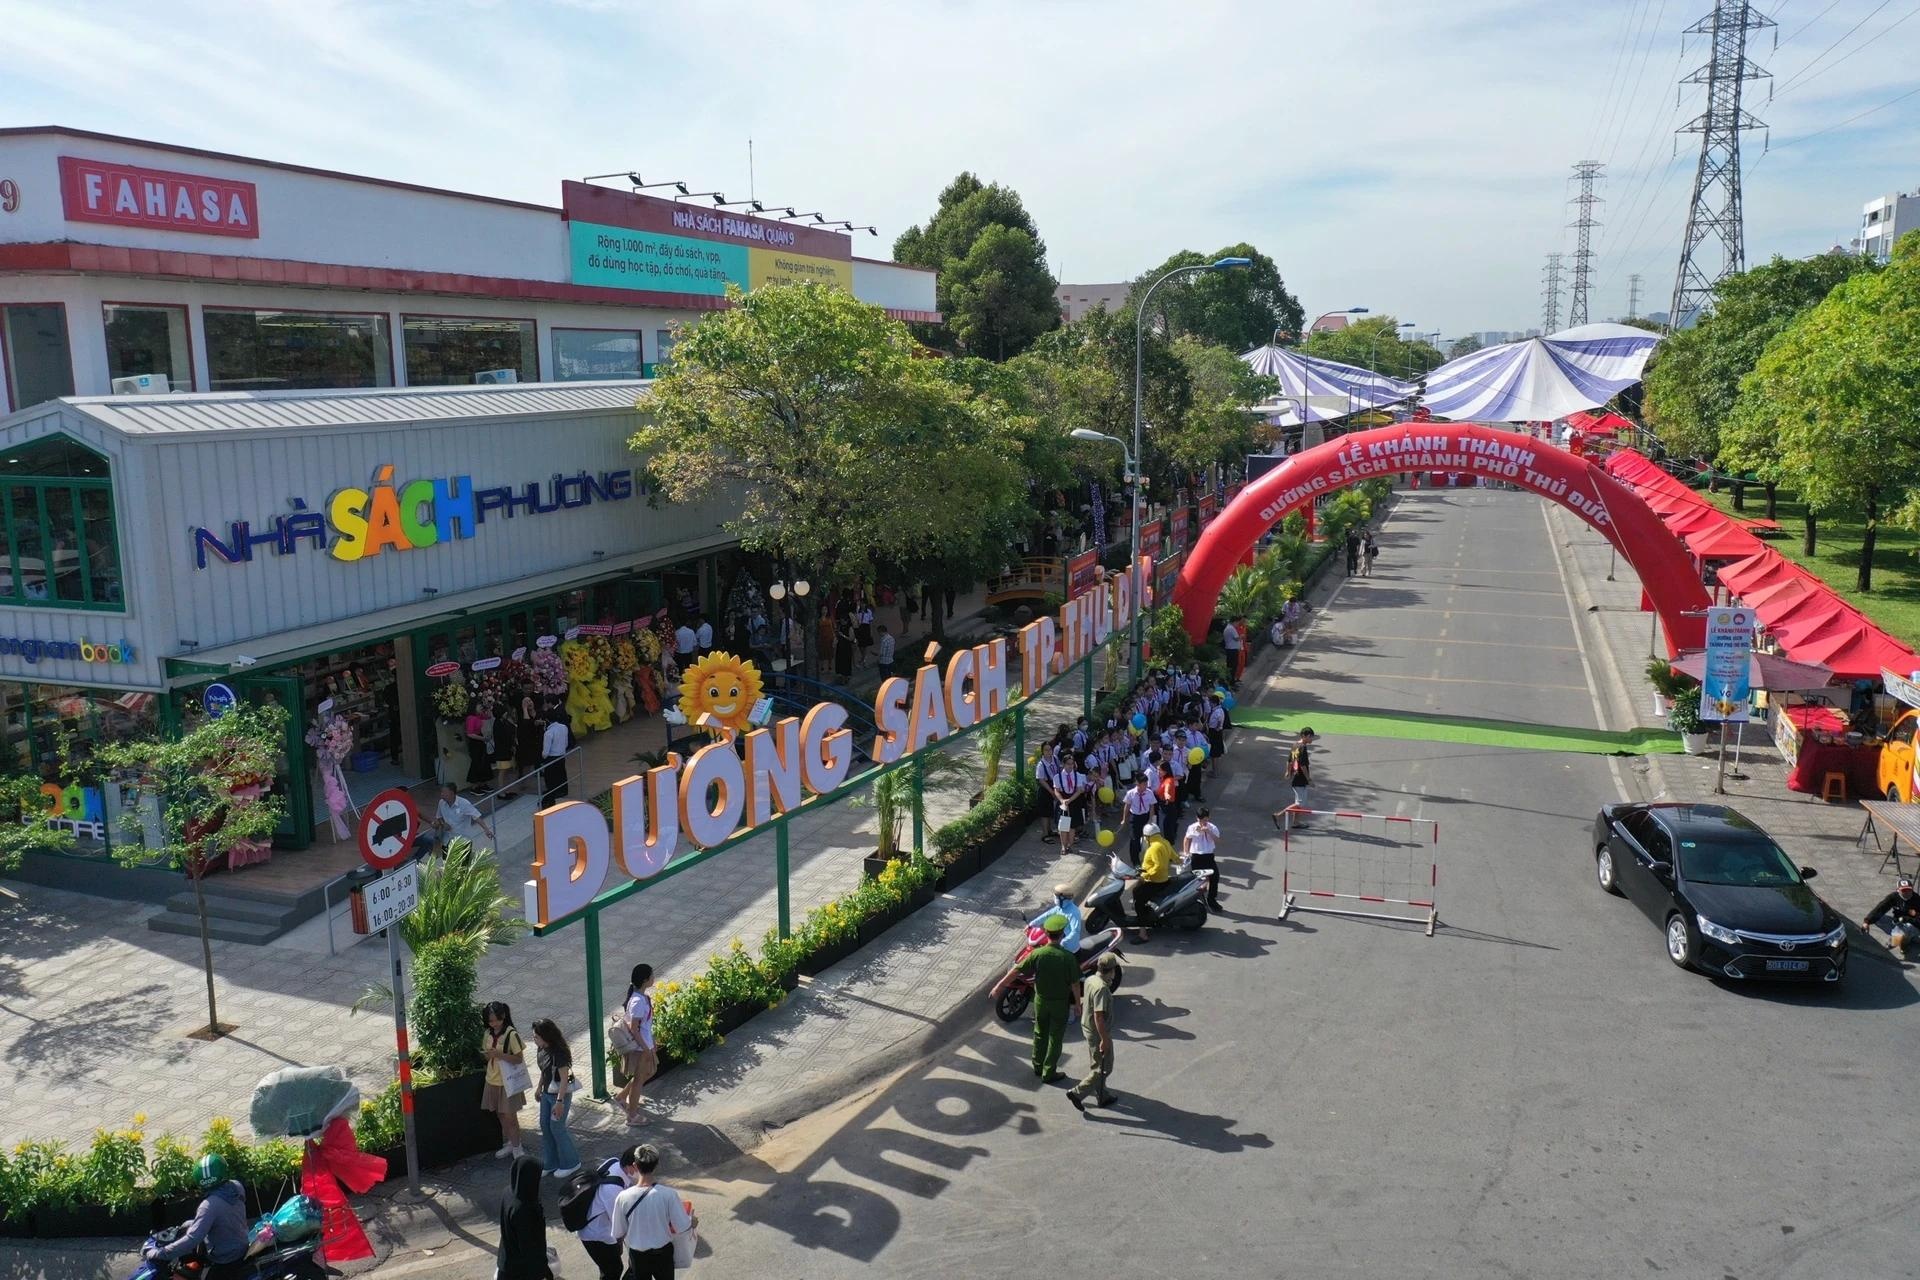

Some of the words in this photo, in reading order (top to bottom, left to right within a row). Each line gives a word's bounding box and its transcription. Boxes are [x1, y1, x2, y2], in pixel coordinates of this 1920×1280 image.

[85, 174, 248, 226] FAHASA
[597, 235, 620, 252] Rộng
[623, 238, 644, 253] 1.000
[685, 247, 705, 261] sách,
[673, 210, 695, 229] NHÀ
[696, 213, 721, 234] SÁCH
[722, 218, 765, 241] FAHASA
[765, 229, 789, 247] QUẬN
[788, 231, 795, 247] 9
[602, 255, 626, 273] dùng
[628, 258, 644, 275] học
[1338, 442, 1364, 466] LỄ
[1368, 434, 1448, 458] KHÁNH
[1458, 437, 1536, 468] THÀNH
[1259, 475, 1328, 521] ĐƯỜNG
[1328, 457, 1388, 484] SÁCH
[1393, 452, 1467, 468] THÀNH
[1472, 456, 1520, 477] PHỐ
[1525, 467, 1568, 496] THỦ
[1567, 490, 1612, 526] ĐỨC
[195, 497, 326, 570] NHÀ
[329, 464, 476, 562] SÁCH
[476, 470, 632, 524] PHƯƠNG
[531, 702, 853, 926] ĐƯỜNG
[872, 640, 1006, 764] SÁCH
